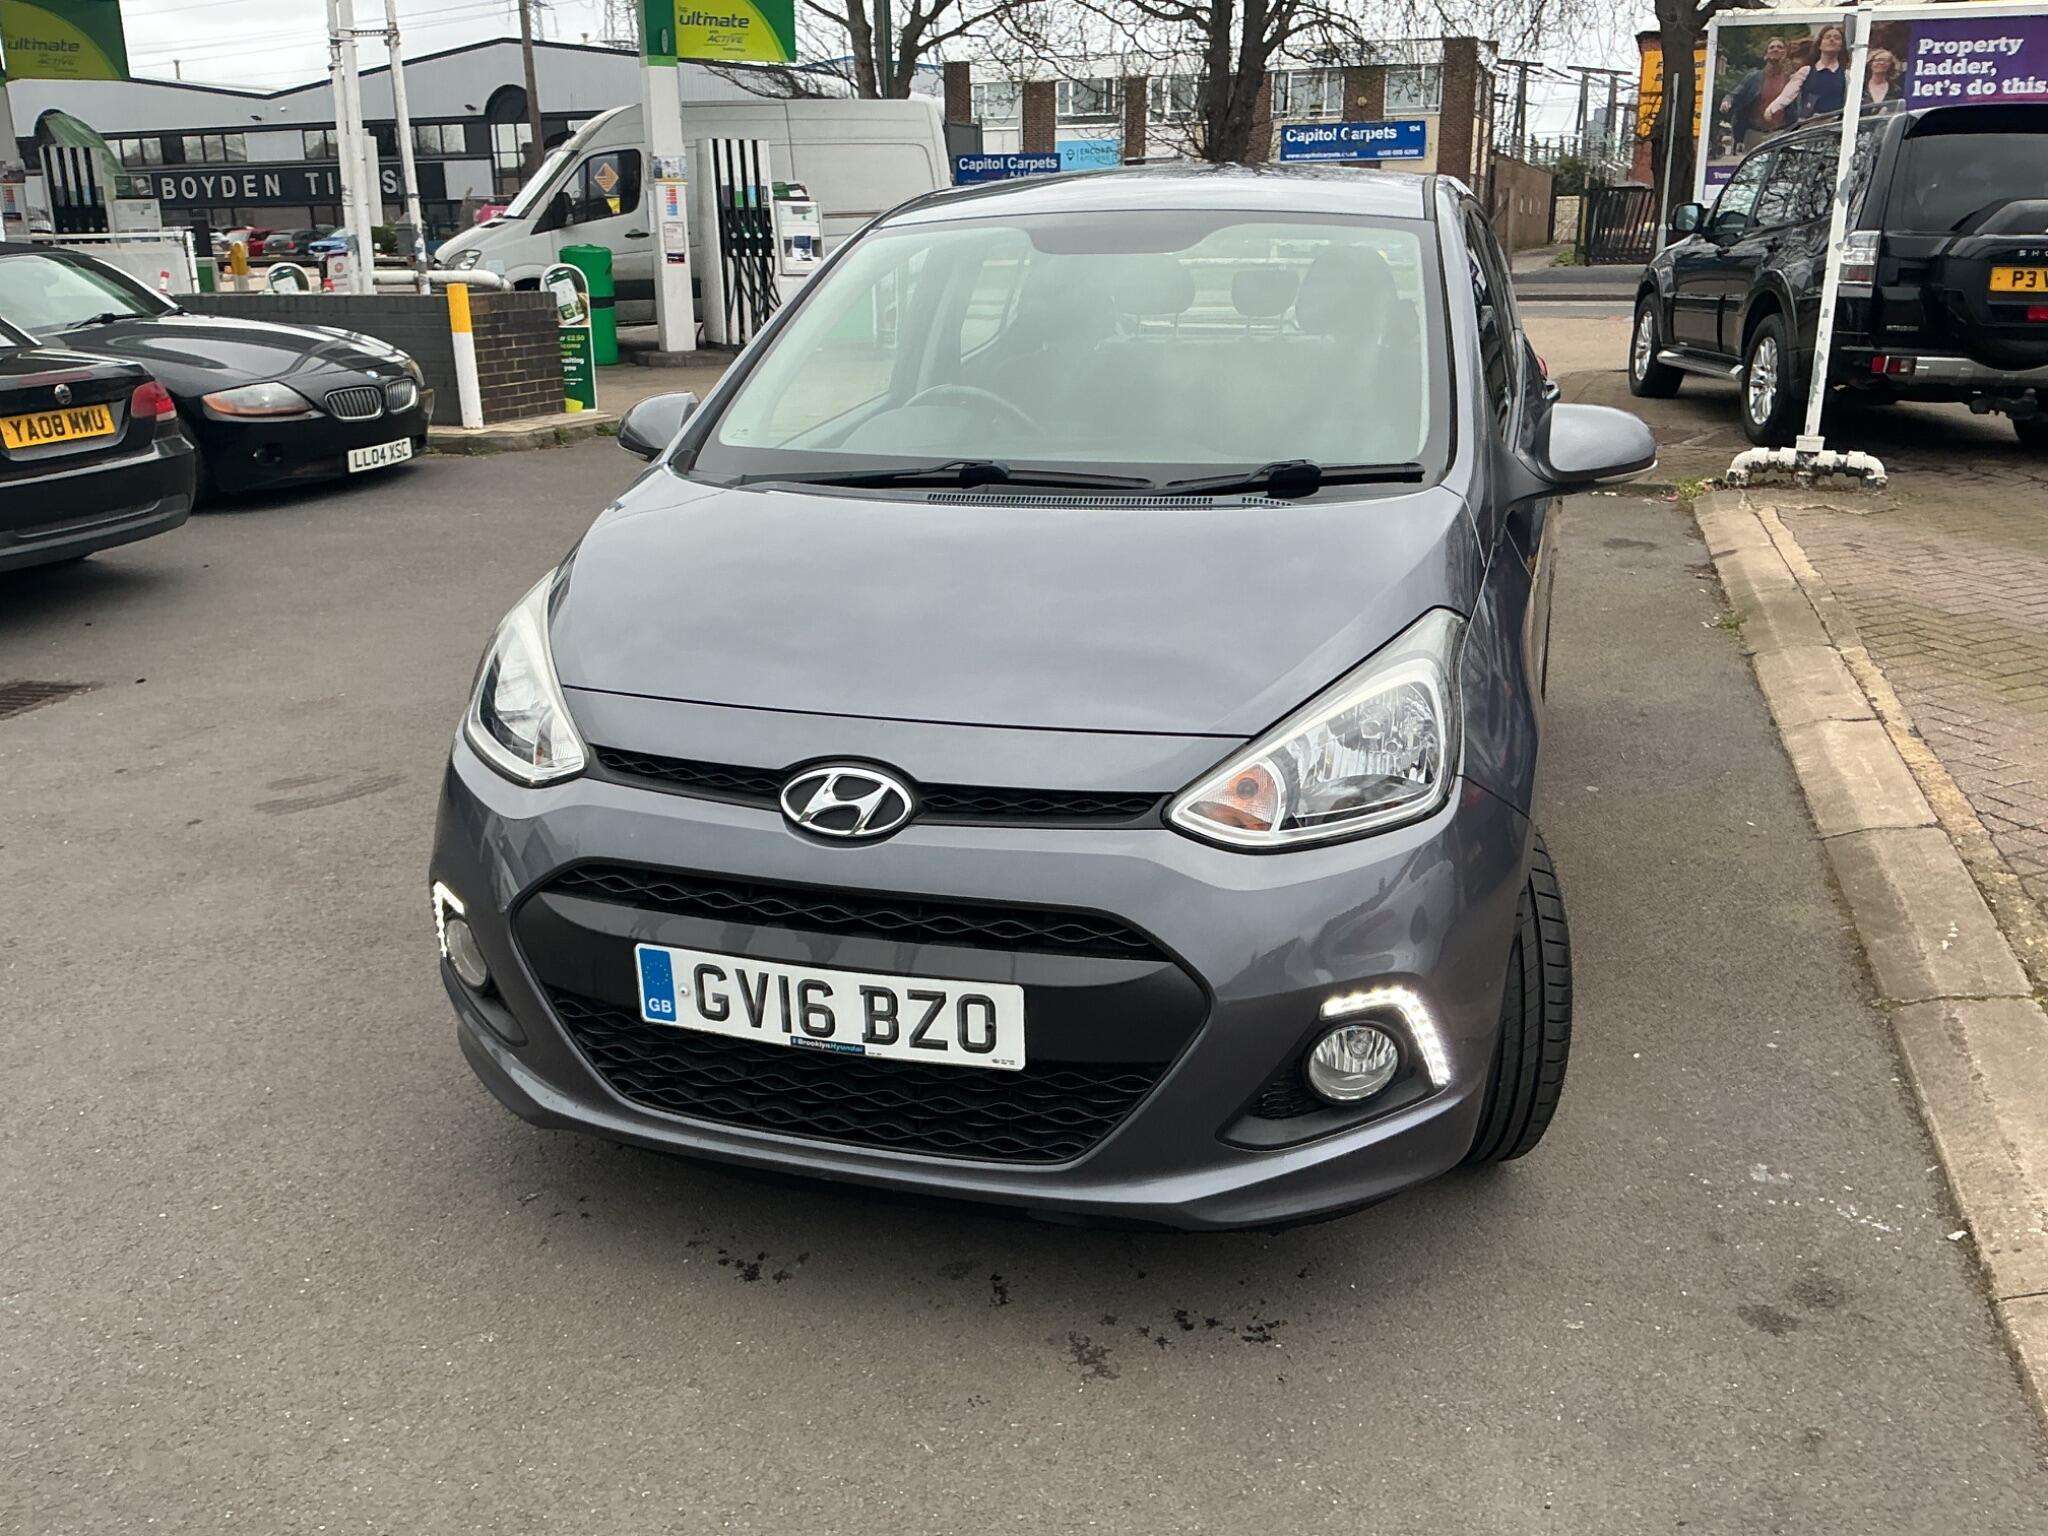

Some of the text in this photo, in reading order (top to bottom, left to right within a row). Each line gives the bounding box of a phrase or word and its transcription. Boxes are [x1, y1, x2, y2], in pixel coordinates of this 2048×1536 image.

[680, 11, 749, 28] ultimate
[8, 37, 80, 52] ultimate
[1918, 37, 2024, 57] Property
[1915, 59, 1997, 76] ladder,
[1912, 79, 1961, 96] let's
[1967, 79, 1996, 95] do
[1286, 126, 1397, 144] Capitol Carpets
[959, 156, 1057, 172] Capitol Carpets
[160, 169, 398, 200] BOYDEN TIS
[2012, 270, 2037, 287] P3
[9, 414, 65, 442] YA08
[354, 441, 408, 468] LL04 XSC
[648, 997, 672, 1014] GB
[693, 963, 836, 1038] GV16
